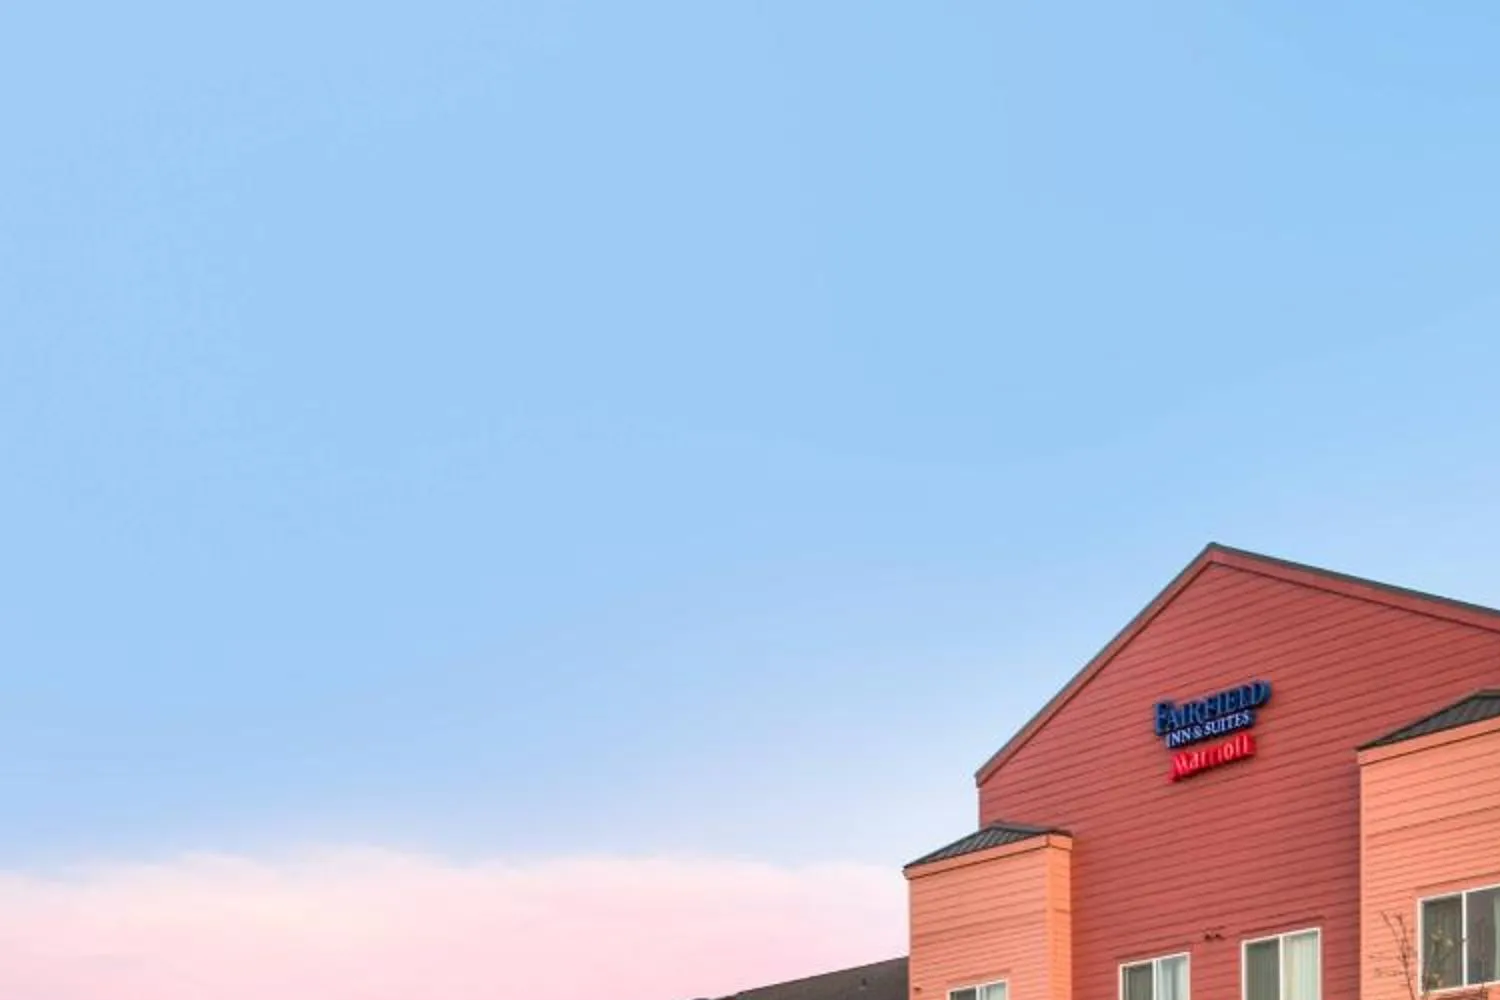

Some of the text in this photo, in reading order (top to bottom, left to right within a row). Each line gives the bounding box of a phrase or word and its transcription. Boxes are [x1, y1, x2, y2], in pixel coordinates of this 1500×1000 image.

[1154, 680, 1272, 736] FAIRFIELD
[1165, 727, 1192, 748] INN
[1203, 709, 1254, 735] SUITES
[1168, 731, 1256, 783] Marriott
